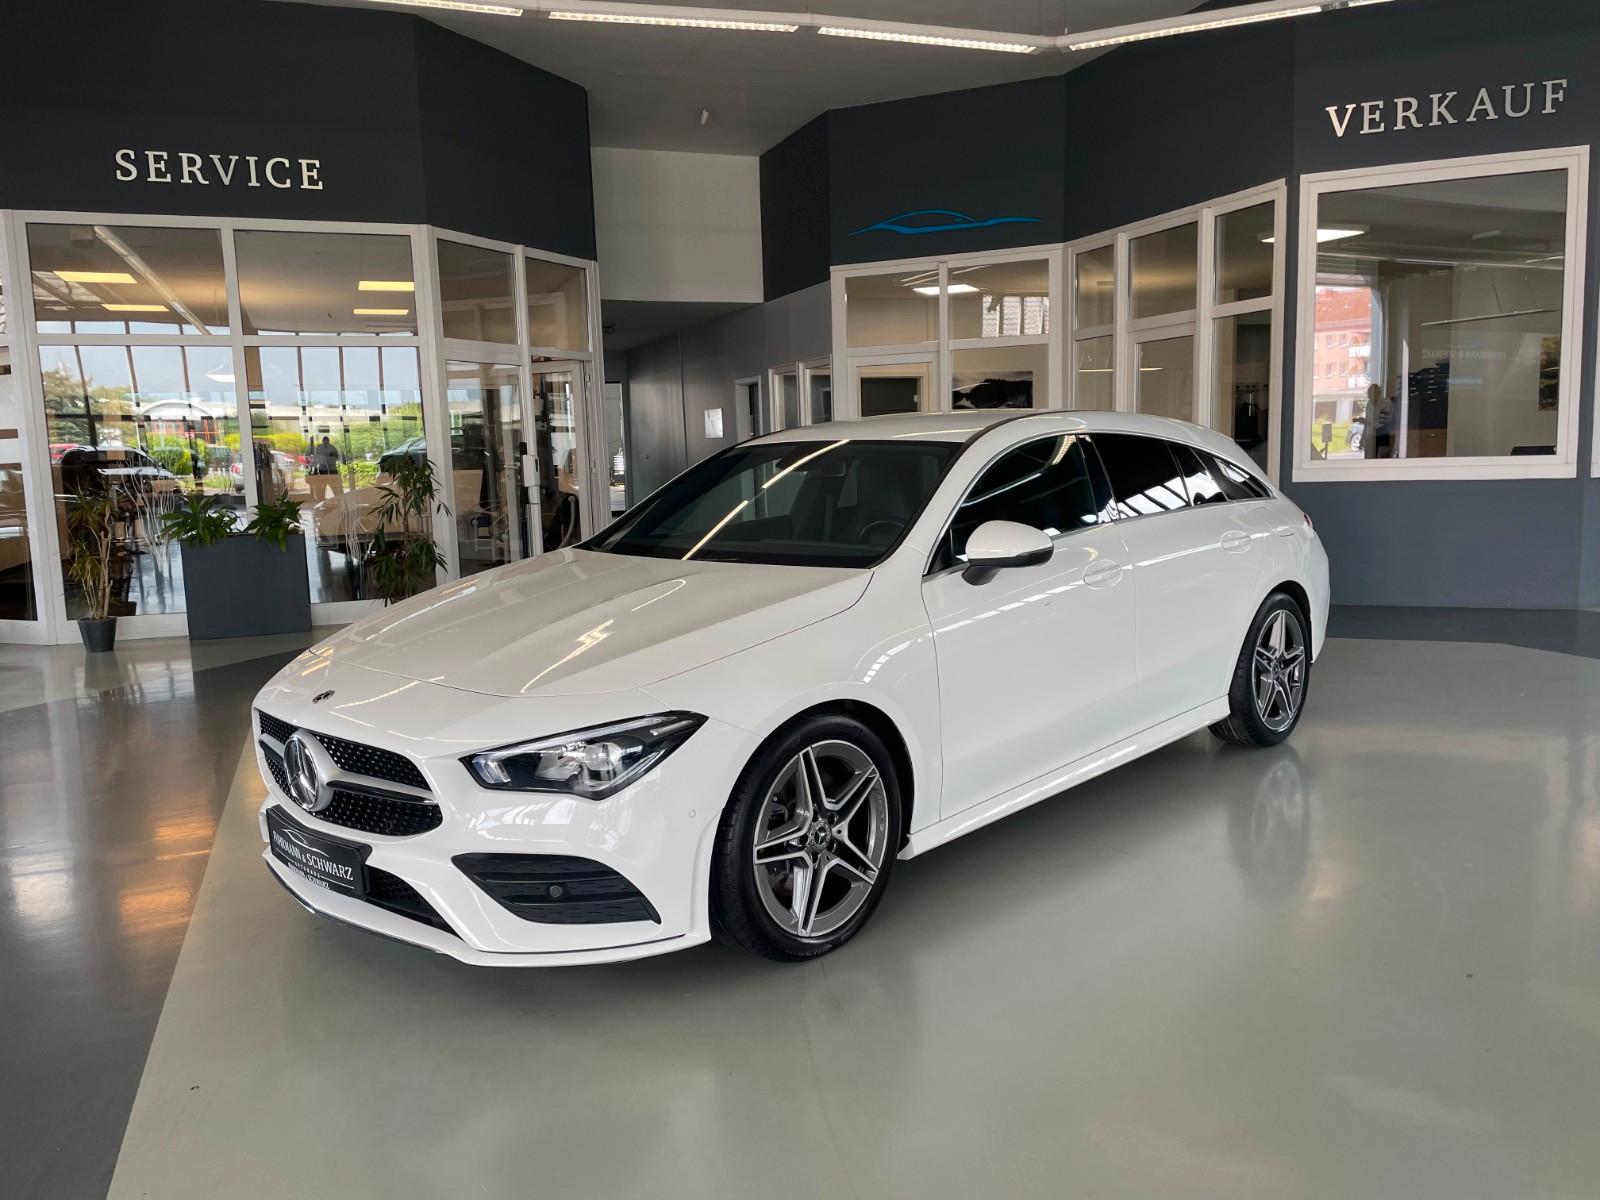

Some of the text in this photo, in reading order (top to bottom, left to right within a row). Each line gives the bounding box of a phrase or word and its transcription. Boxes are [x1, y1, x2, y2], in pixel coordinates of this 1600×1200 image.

[1325, 79, 1568, 138] VERKAUF
[115, 149, 324, 190] SERVICE
[306, 853, 354, 881] SCHWARZ
